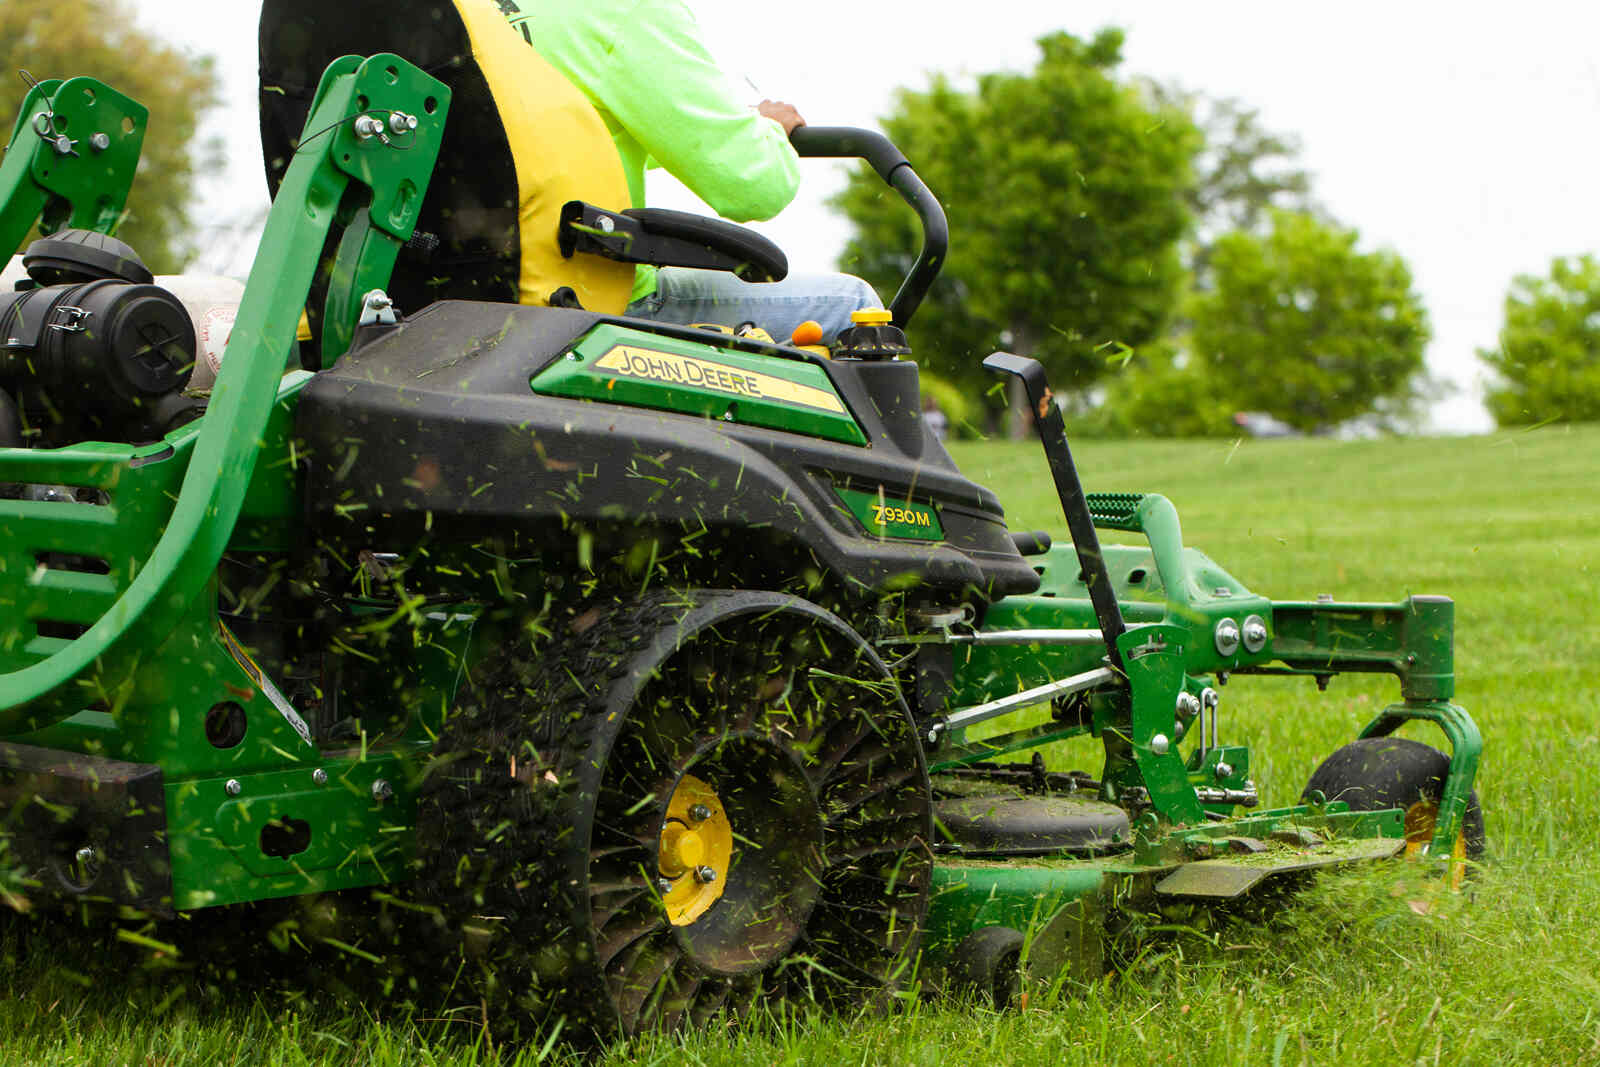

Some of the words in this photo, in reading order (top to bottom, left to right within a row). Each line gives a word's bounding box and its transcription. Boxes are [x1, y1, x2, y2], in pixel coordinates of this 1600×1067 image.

[620, 350, 682, 380] JOHN
[684, 360, 762, 395] DEERE
[872, 505, 930, 527] Z930M
